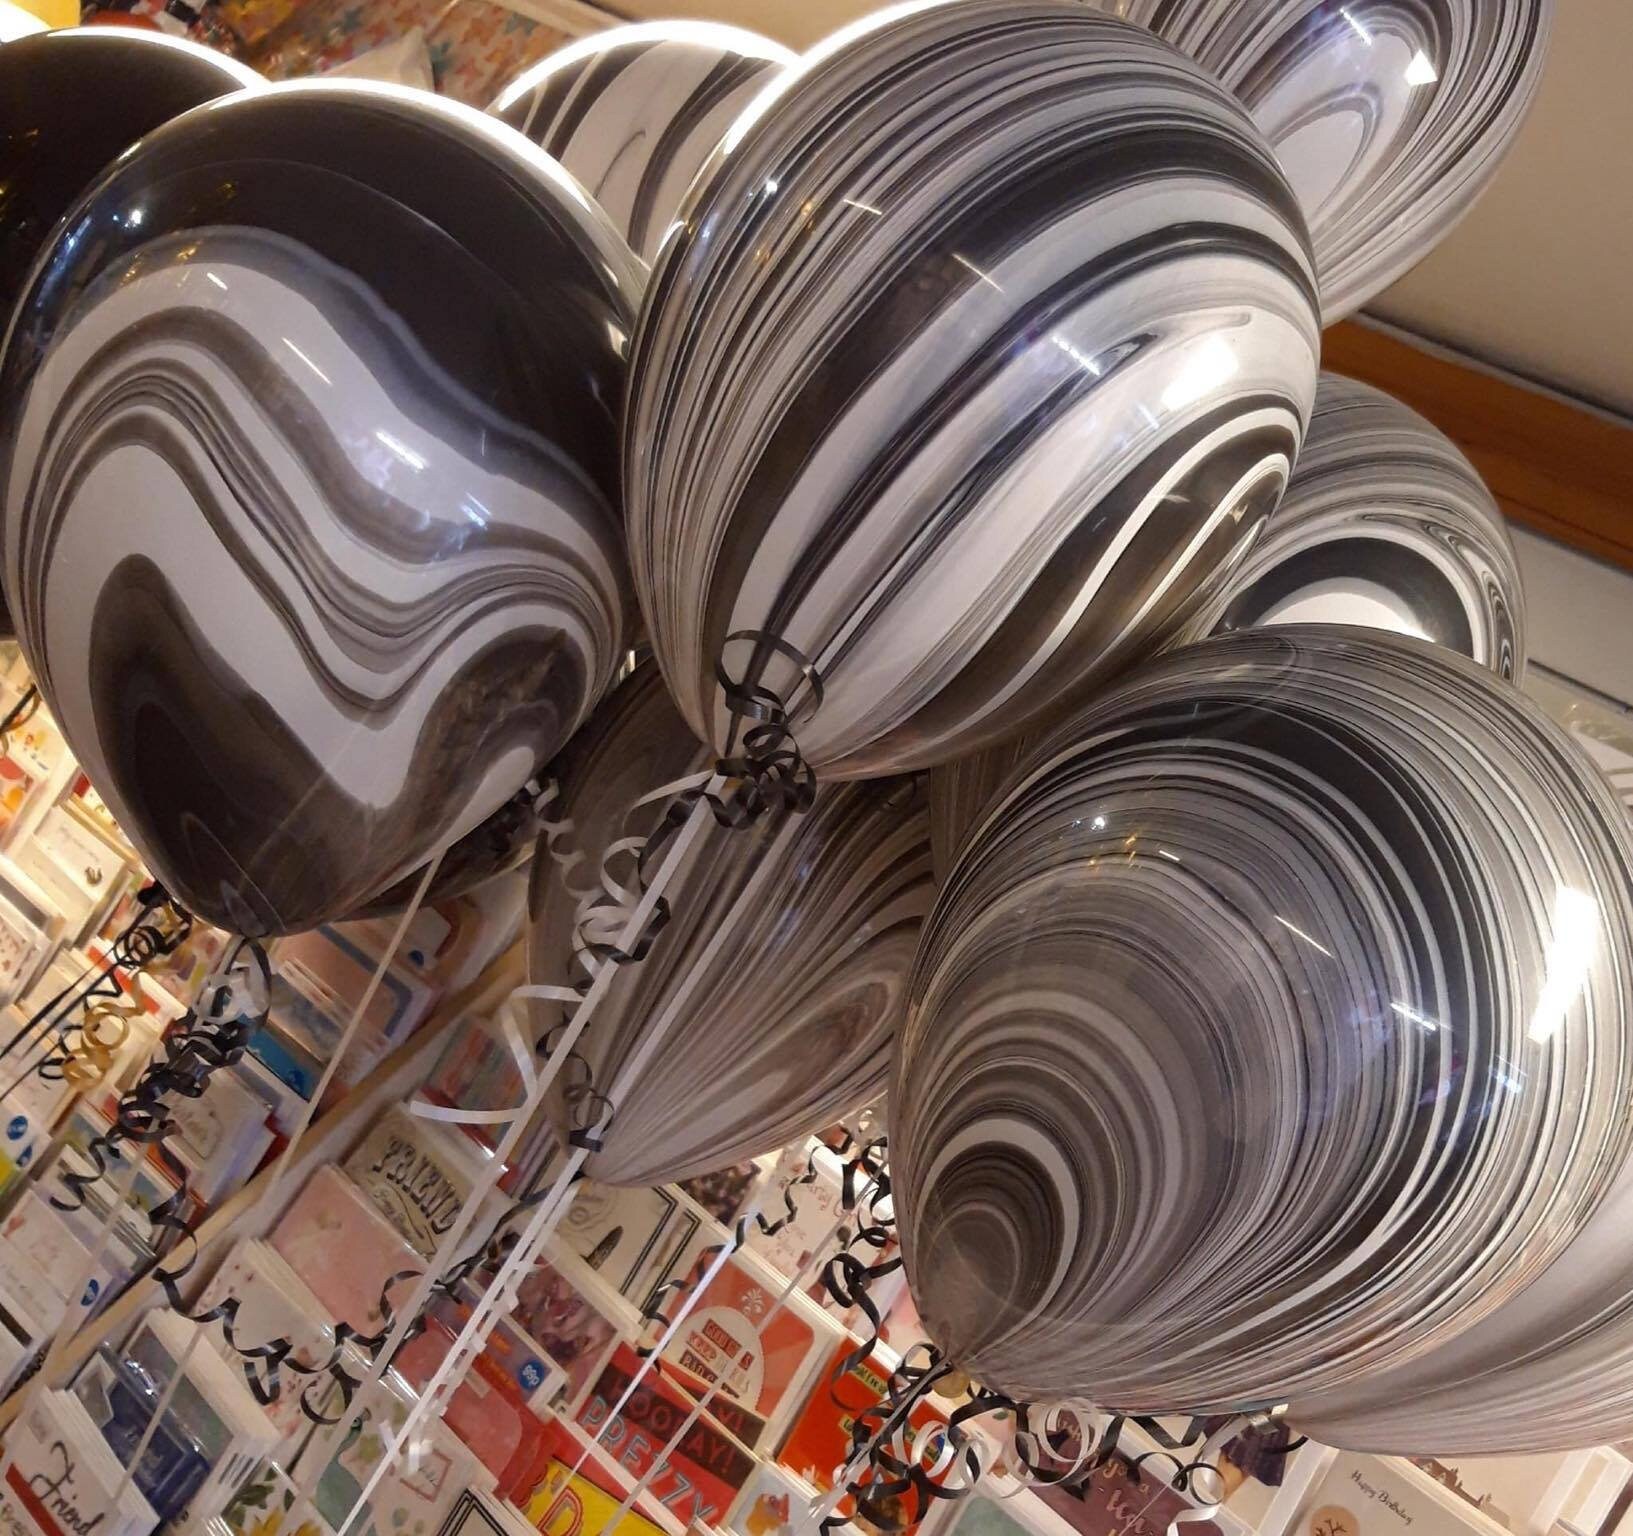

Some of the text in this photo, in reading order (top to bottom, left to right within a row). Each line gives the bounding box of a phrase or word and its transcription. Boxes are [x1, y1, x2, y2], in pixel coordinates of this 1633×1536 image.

[606, 1374, 735, 1474] HOOAY!
[29, 1440, 105, 1536] Friend
[1351, 1470, 1413, 1526] Happy Birthday
